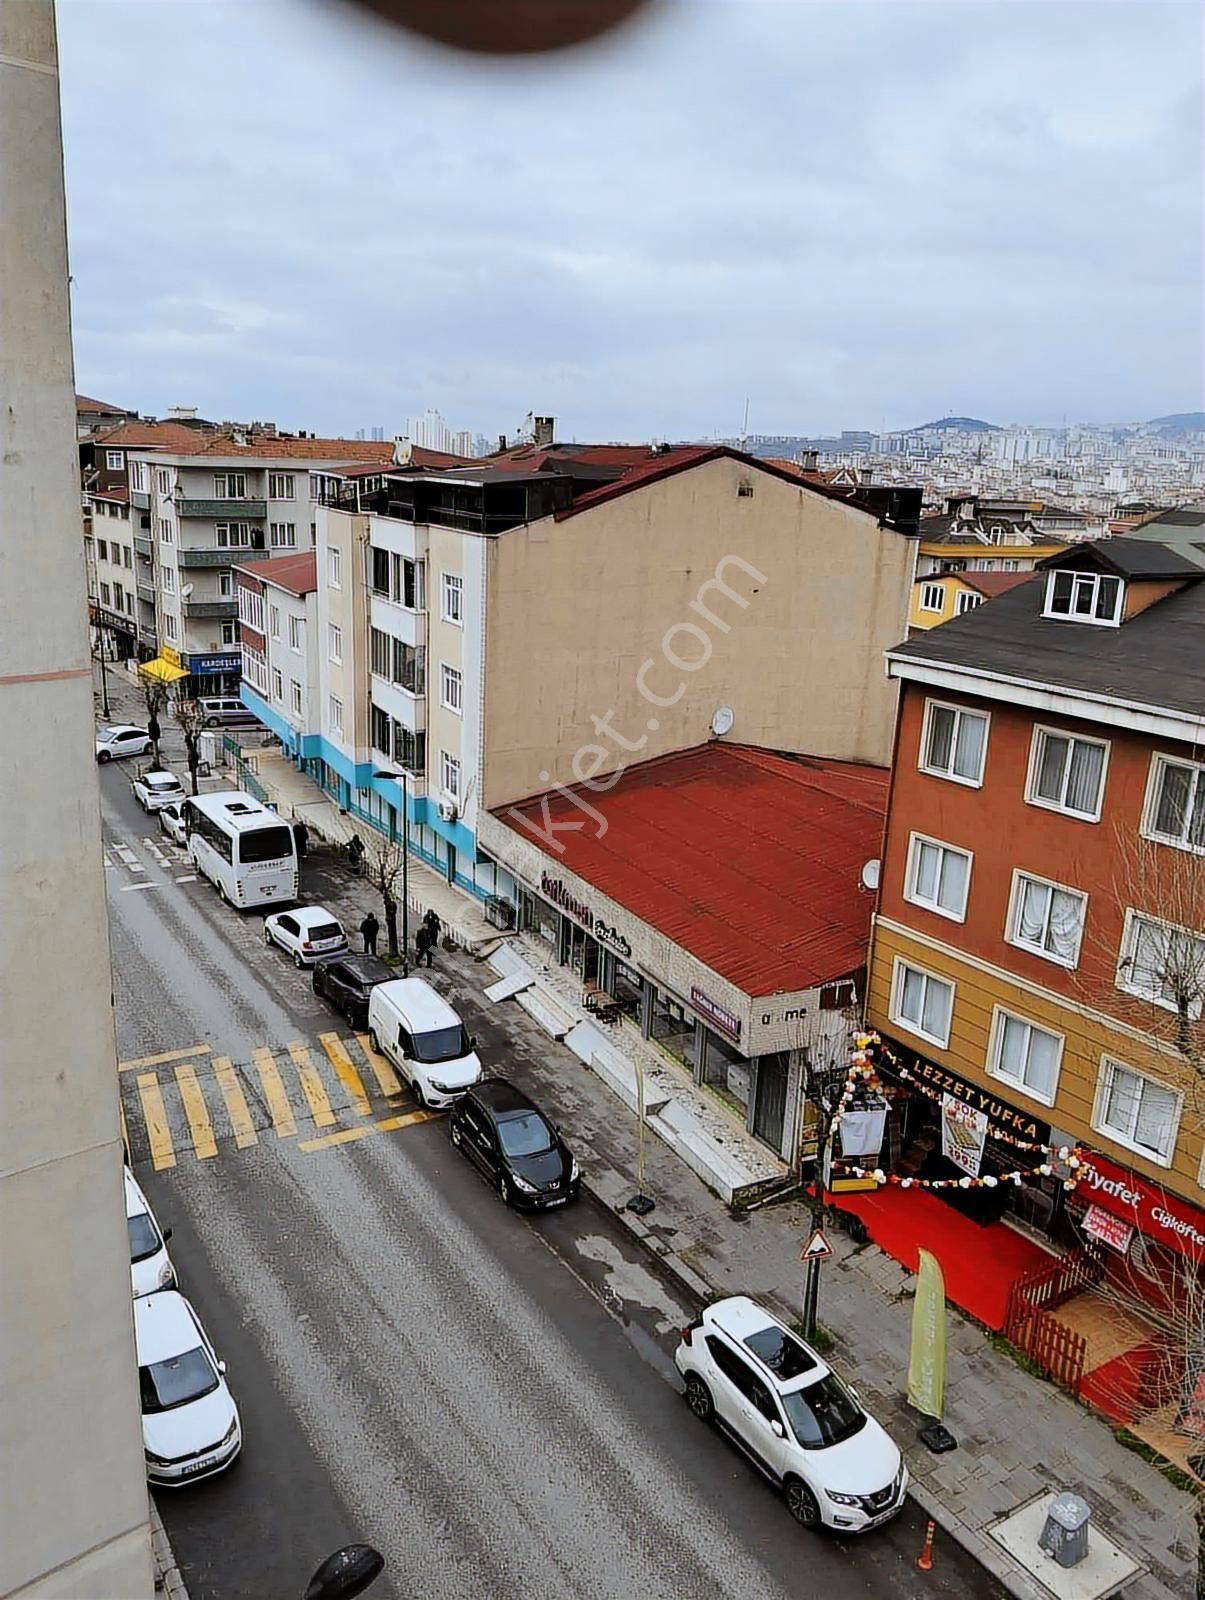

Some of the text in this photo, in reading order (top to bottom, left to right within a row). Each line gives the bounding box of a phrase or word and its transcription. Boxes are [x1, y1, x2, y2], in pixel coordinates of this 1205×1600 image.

[913, 1060, 976, 1101] LEZZET
[979, 1094, 1037, 1138] YUFKA
[1081, 1161, 1141, 1208] Ziyafet
